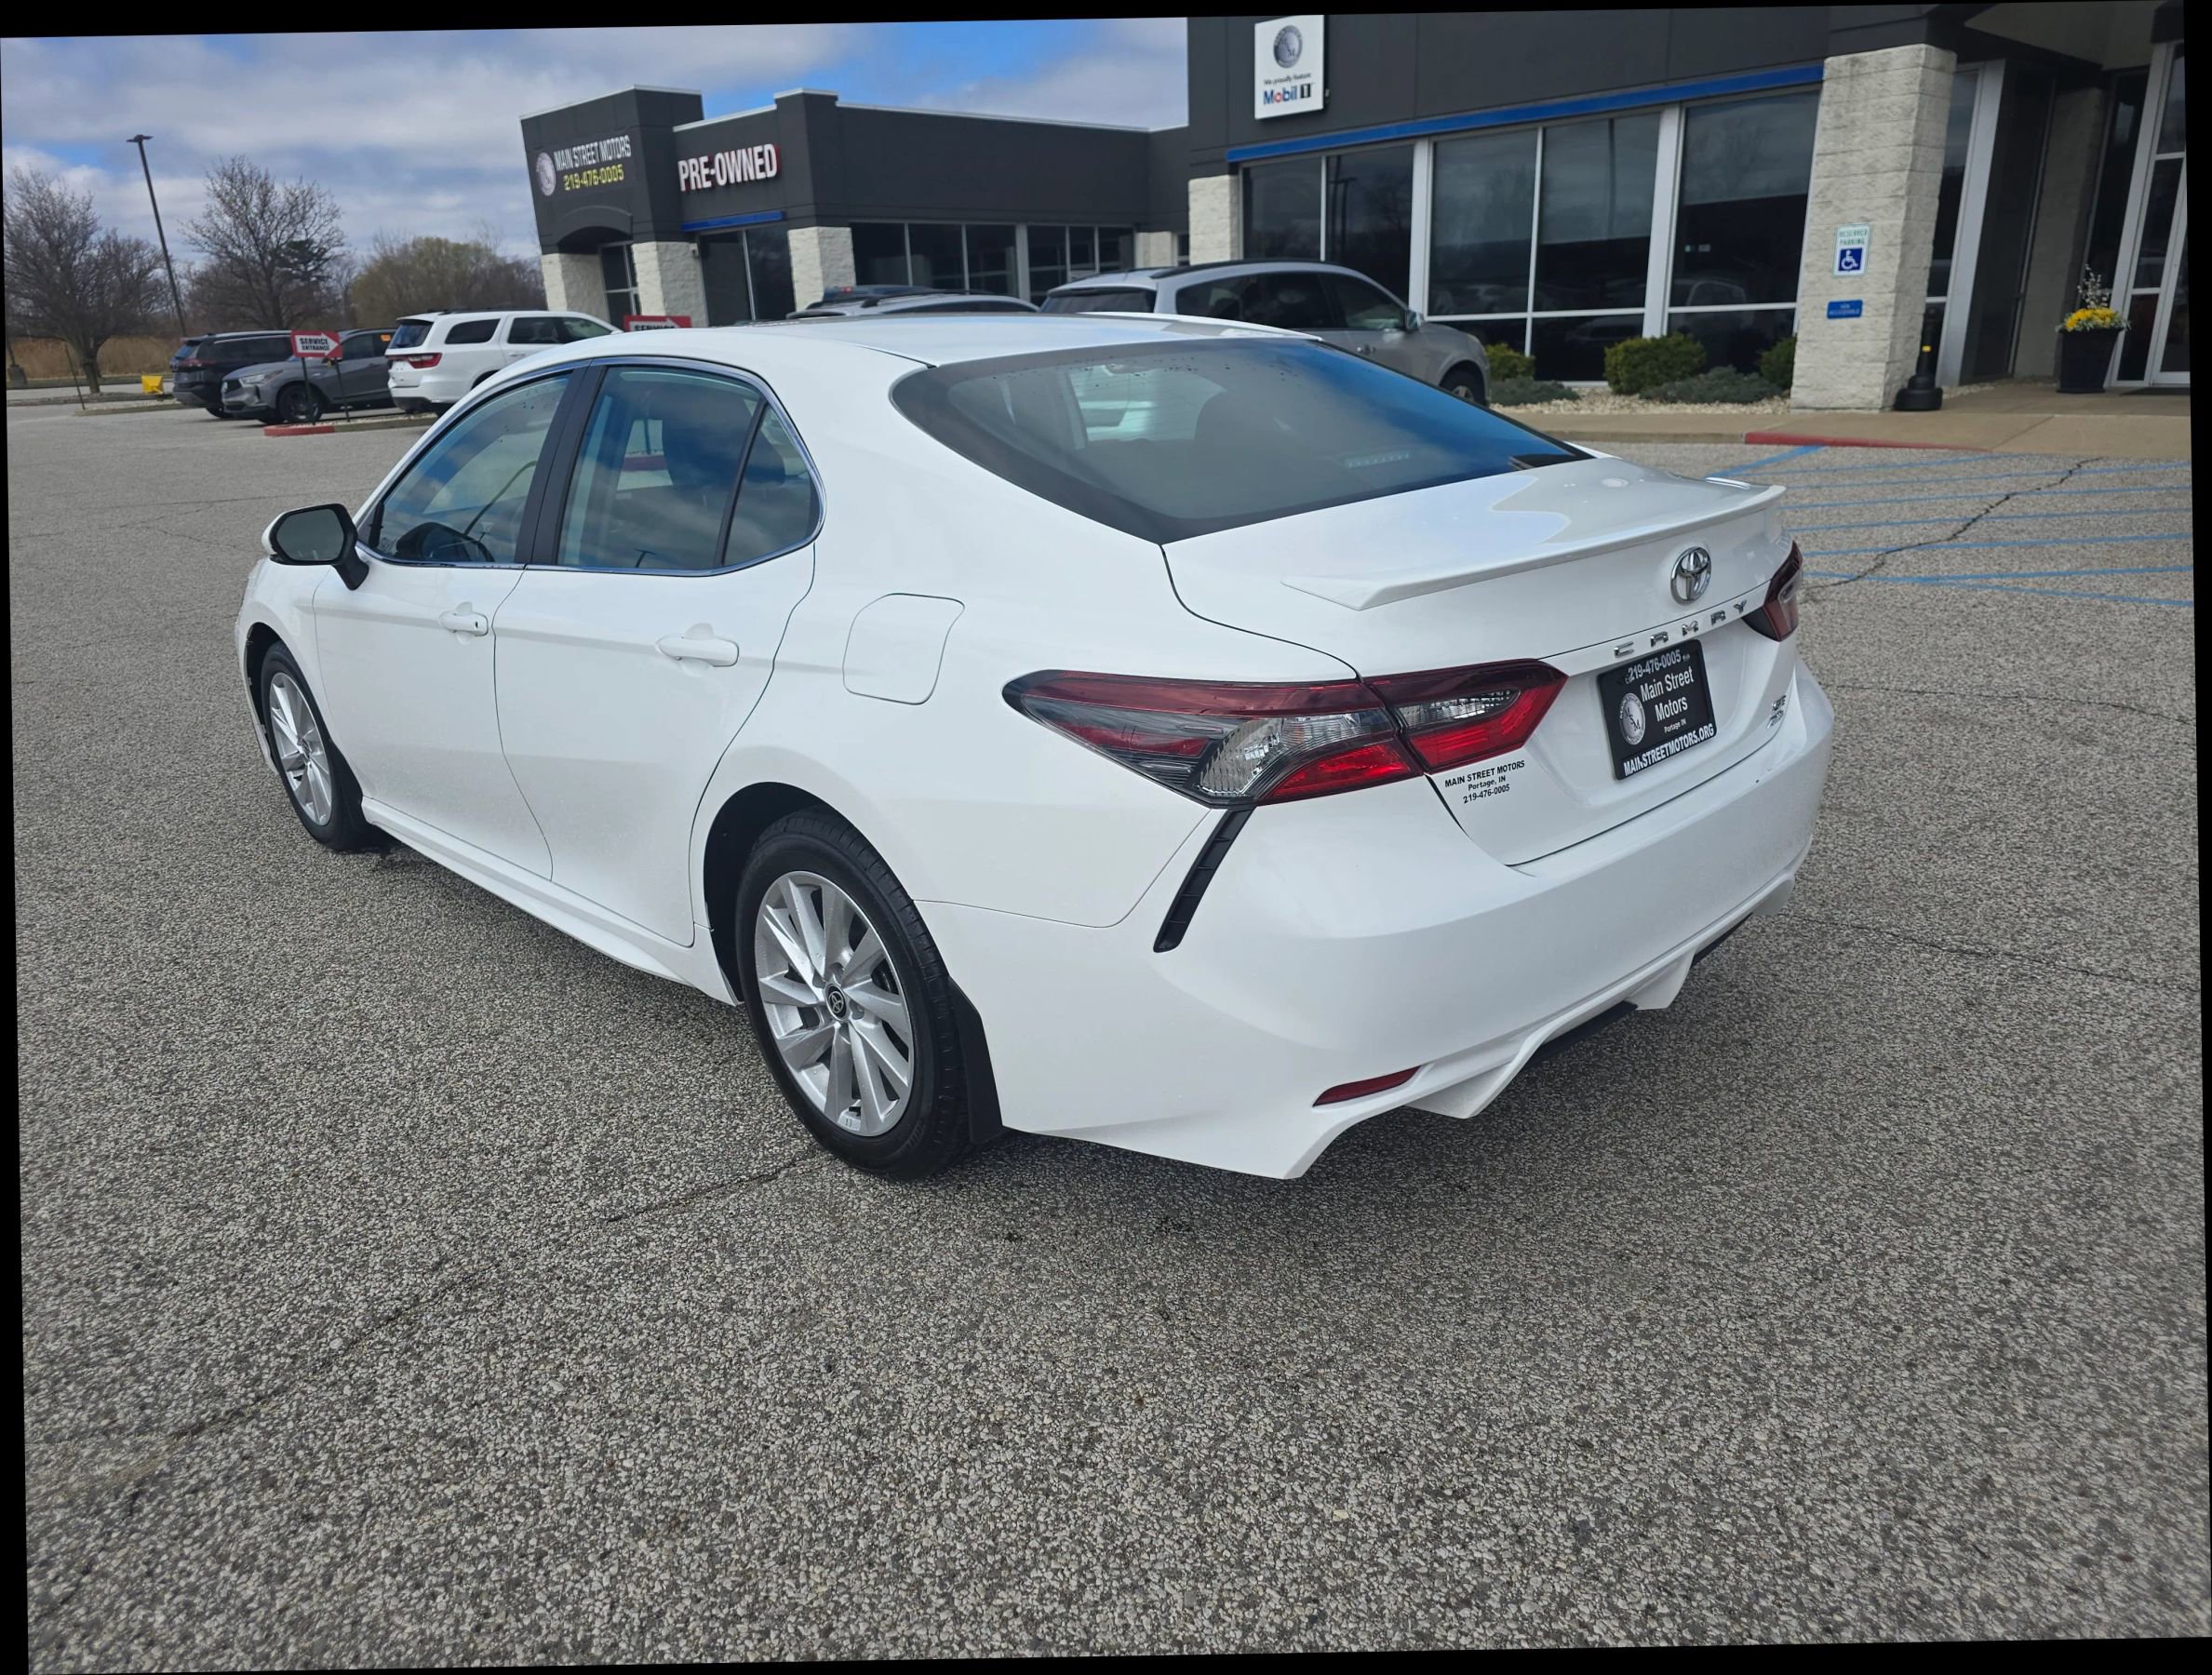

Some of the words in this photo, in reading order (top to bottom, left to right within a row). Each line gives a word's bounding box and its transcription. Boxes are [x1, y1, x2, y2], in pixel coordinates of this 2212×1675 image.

[1264, 86, 1297, 104] Mobil
[553, 149, 574, 171] MAIN
[572, 141, 600, 168] STREET
[599, 135, 632, 162] MOTORS
[563, 164, 624, 191] 219-476-0005
[677, 143, 779, 192] PRE-OWNED
[1614, 599, 1748, 658] CAMRY
[1628, 650, 1682, 682] 219-476-0005
[1641, 679, 1664, 702] Main
[1665, 666, 1694, 691] Street
[1655, 697, 1688, 722] Motors
[1664, 722, 1681, 733] Portage
[1444, 776, 1466, 787] MAIN
[1468, 768, 1495, 782] STREET
[1496, 760, 1525, 774] MOTORS
[1468, 779, 1497, 791] Portage,
[1498, 775, 1506, 784] IN
[1463, 784, 1510, 804] 219-476-0005
